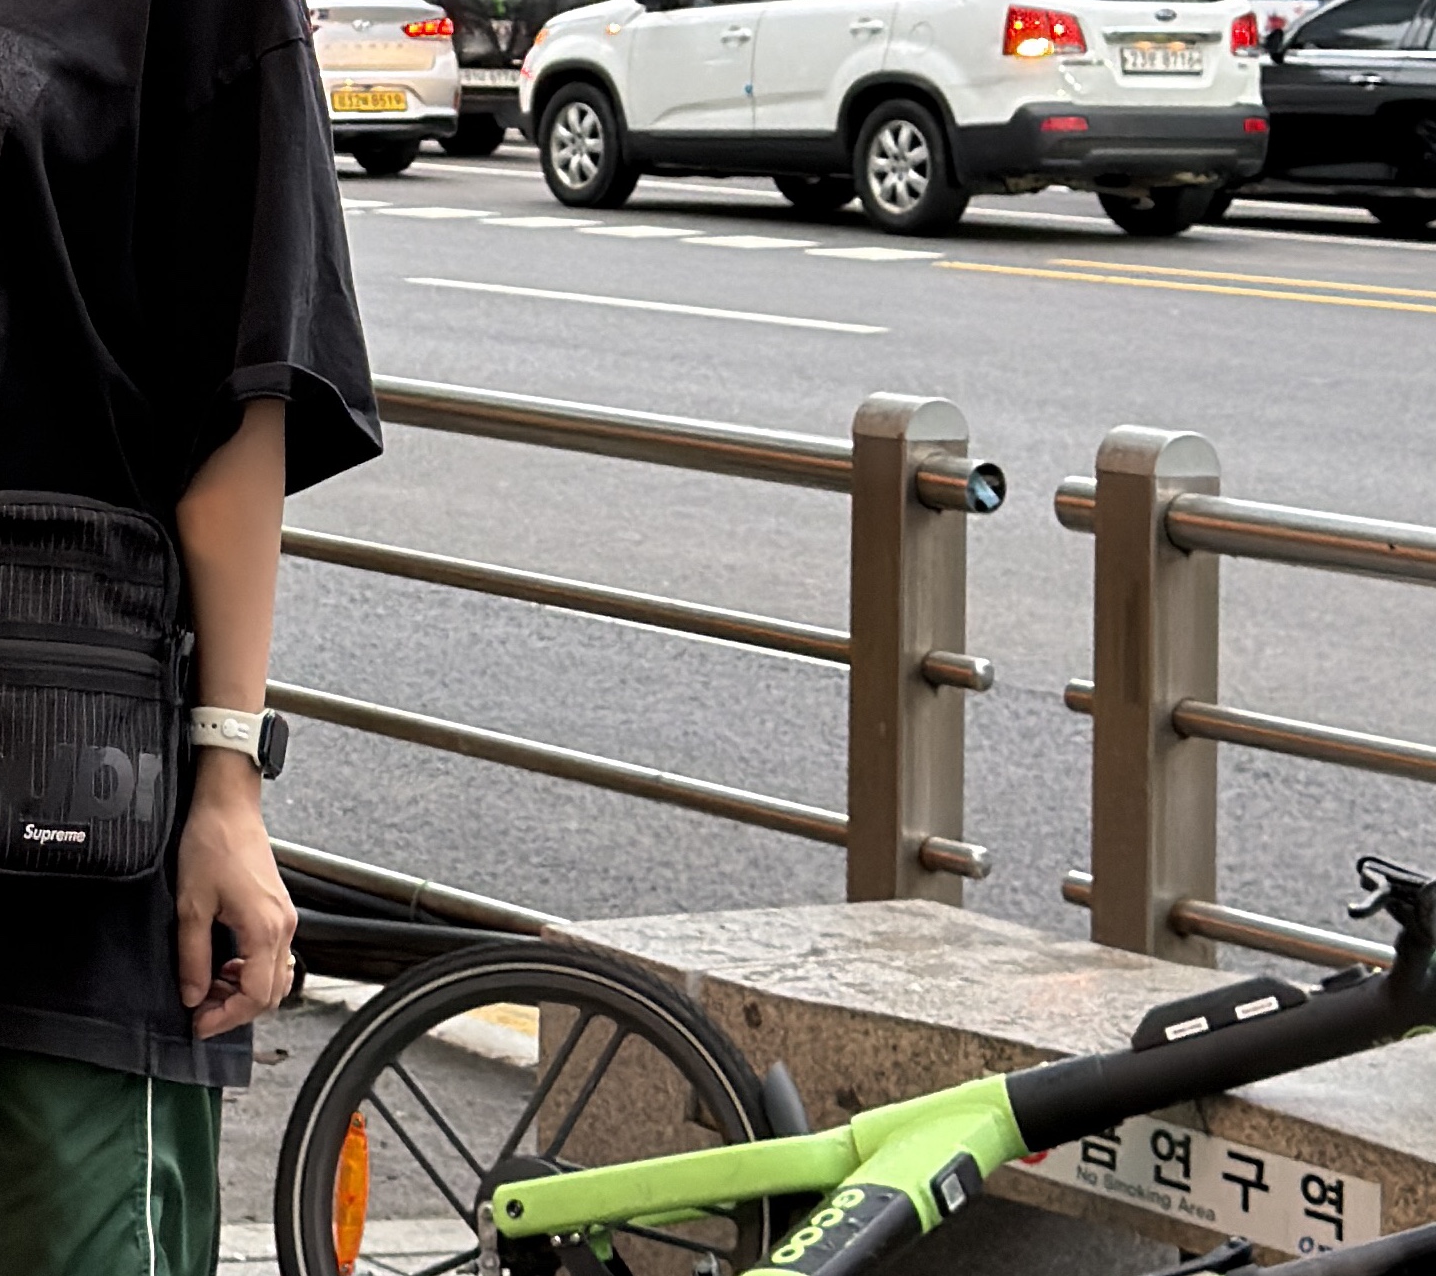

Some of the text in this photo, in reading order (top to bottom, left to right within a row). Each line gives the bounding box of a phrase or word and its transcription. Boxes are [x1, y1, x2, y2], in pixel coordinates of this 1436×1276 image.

[23, 824, 87, 845] Supreme
[1076, 1165, 1217, 1222] No Smoking Area
